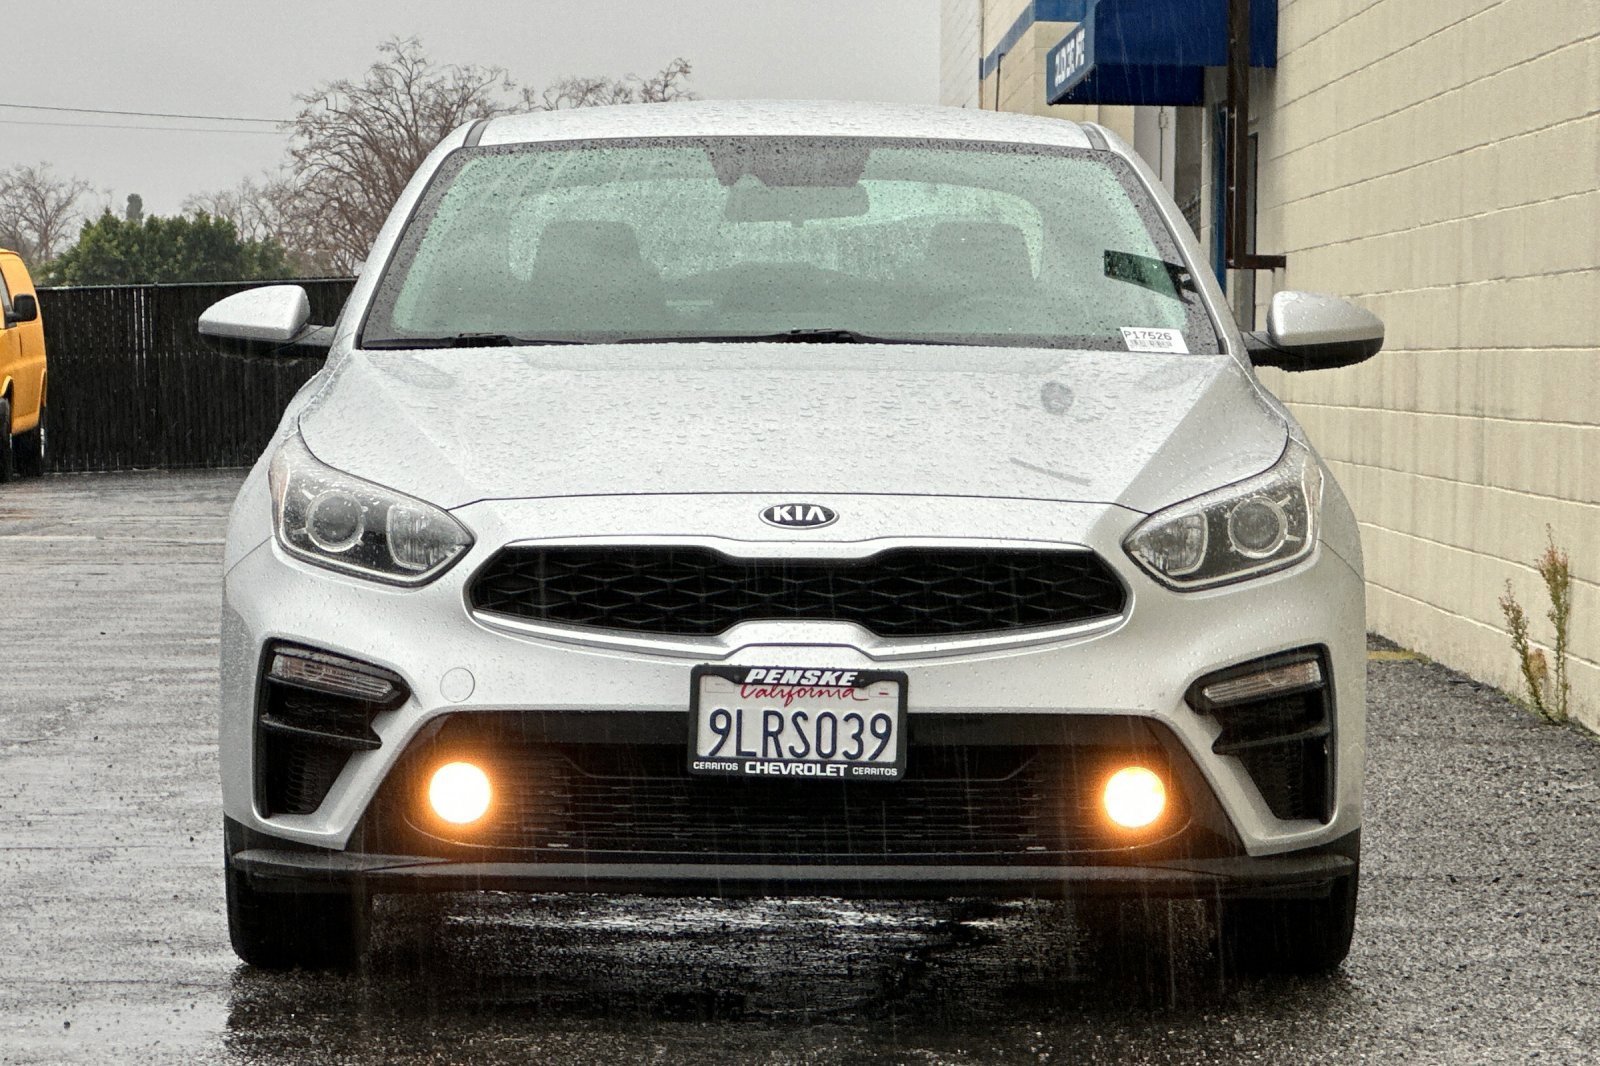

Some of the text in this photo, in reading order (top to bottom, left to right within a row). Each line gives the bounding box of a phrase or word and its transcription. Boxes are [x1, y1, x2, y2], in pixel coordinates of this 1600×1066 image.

[1123, 330, 1172, 341] P17526
[773, 505, 826, 521] KIA
[744, 668, 858, 686] PENSKE
[740, 684, 869, 707] California
[708, 708, 893, 761] 9LRS039
[693, 761, 738, 771] CERRITOS
[744, 762, 848, 777] CHEVROLET
[852, 766, 898, 776] CERRITOS
